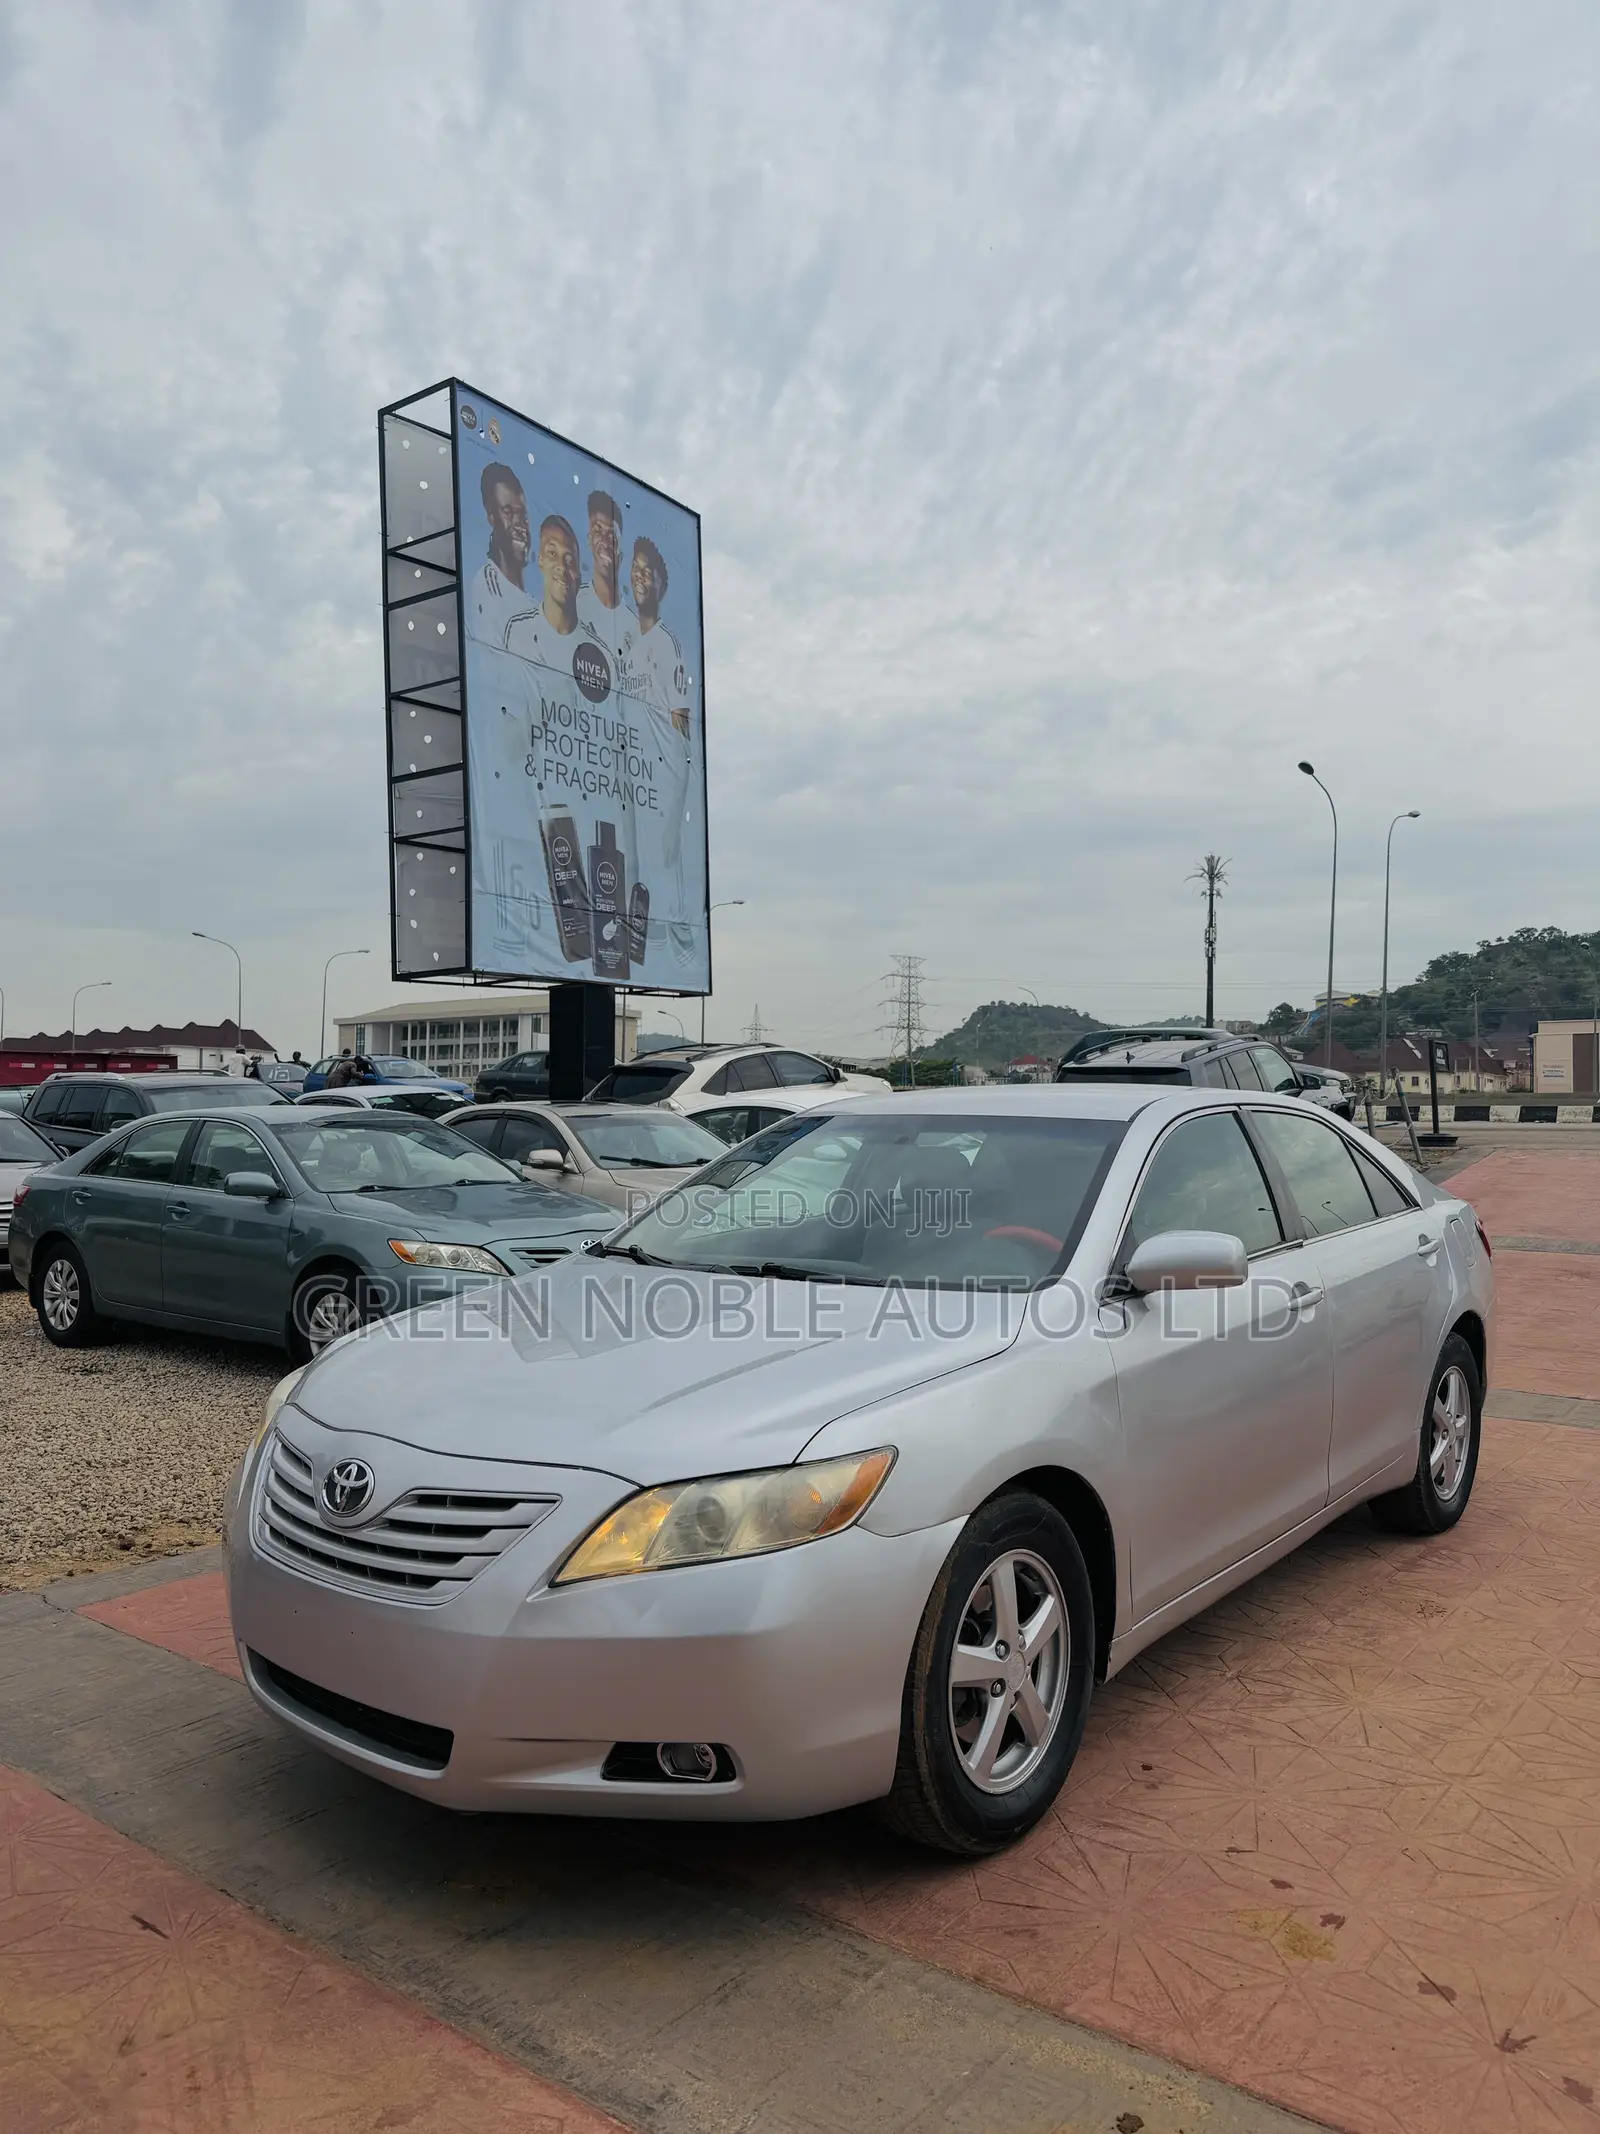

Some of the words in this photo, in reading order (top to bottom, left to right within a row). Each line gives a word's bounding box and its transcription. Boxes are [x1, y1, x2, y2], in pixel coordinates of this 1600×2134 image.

[576, 658, 608, 680] NIVEA
[580, 674, 604, 691] MEN
[541, 697, 644, 755] MOISTURE,
[531, 724, 653, 781] PROTECTION
[525, 753, 537, 778] &
[544, 759, 658, 810] FRAGRANCE
[554, 870, 578, 881] DEEP
[599, 871, 615, 881] NIVEA
[596, 902, 616, 913] DEEP
